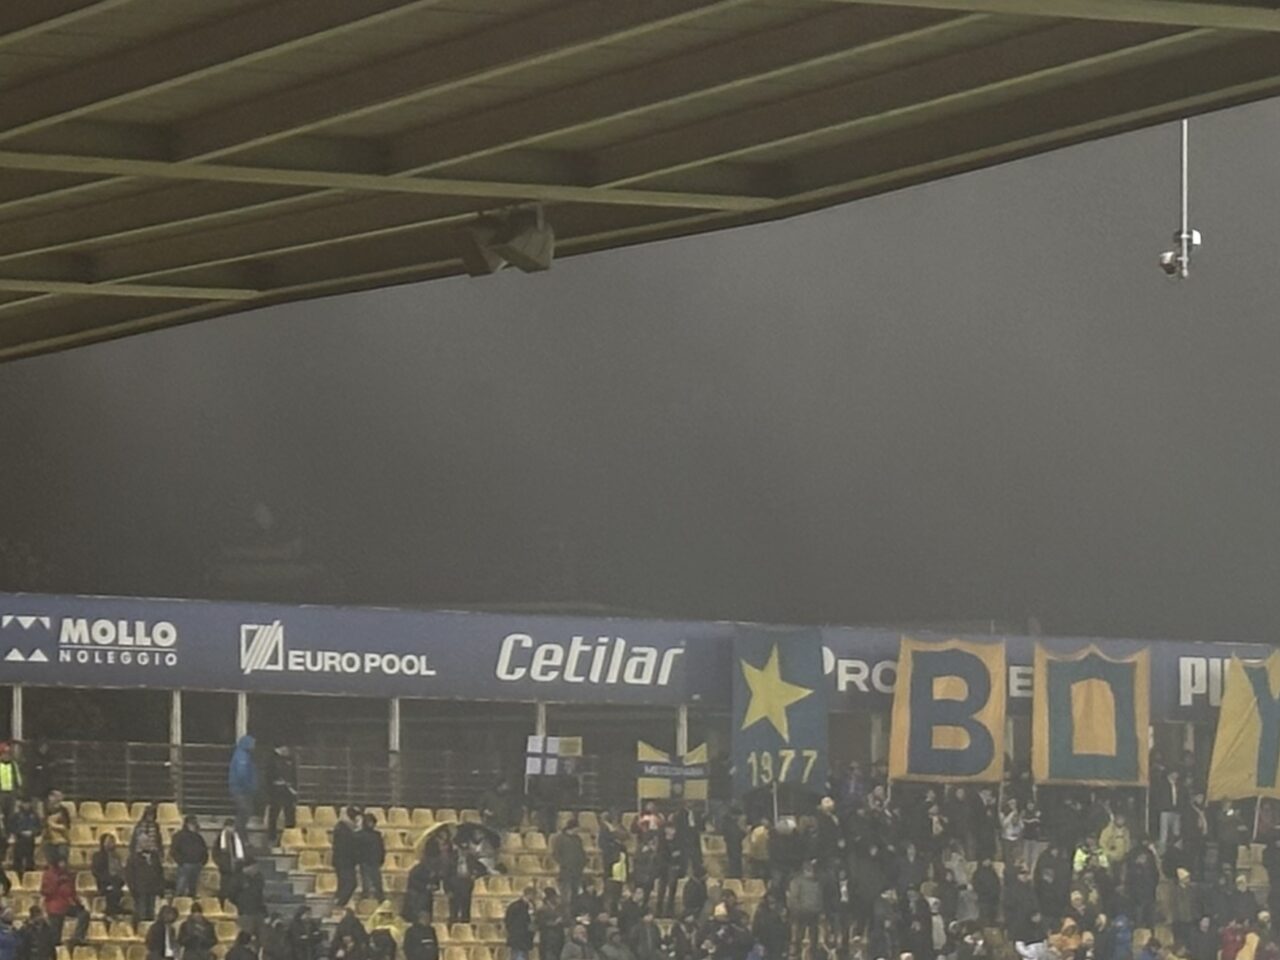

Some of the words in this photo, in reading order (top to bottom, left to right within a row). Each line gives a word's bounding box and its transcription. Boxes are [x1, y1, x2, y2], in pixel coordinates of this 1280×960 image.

[60, 618, 178, 647] MOLLO
[59, 650, 178, 667] NOLEGGIO
[496, 633, 686, 685] Cetilar
[748, 749, 818, 787] 1977
